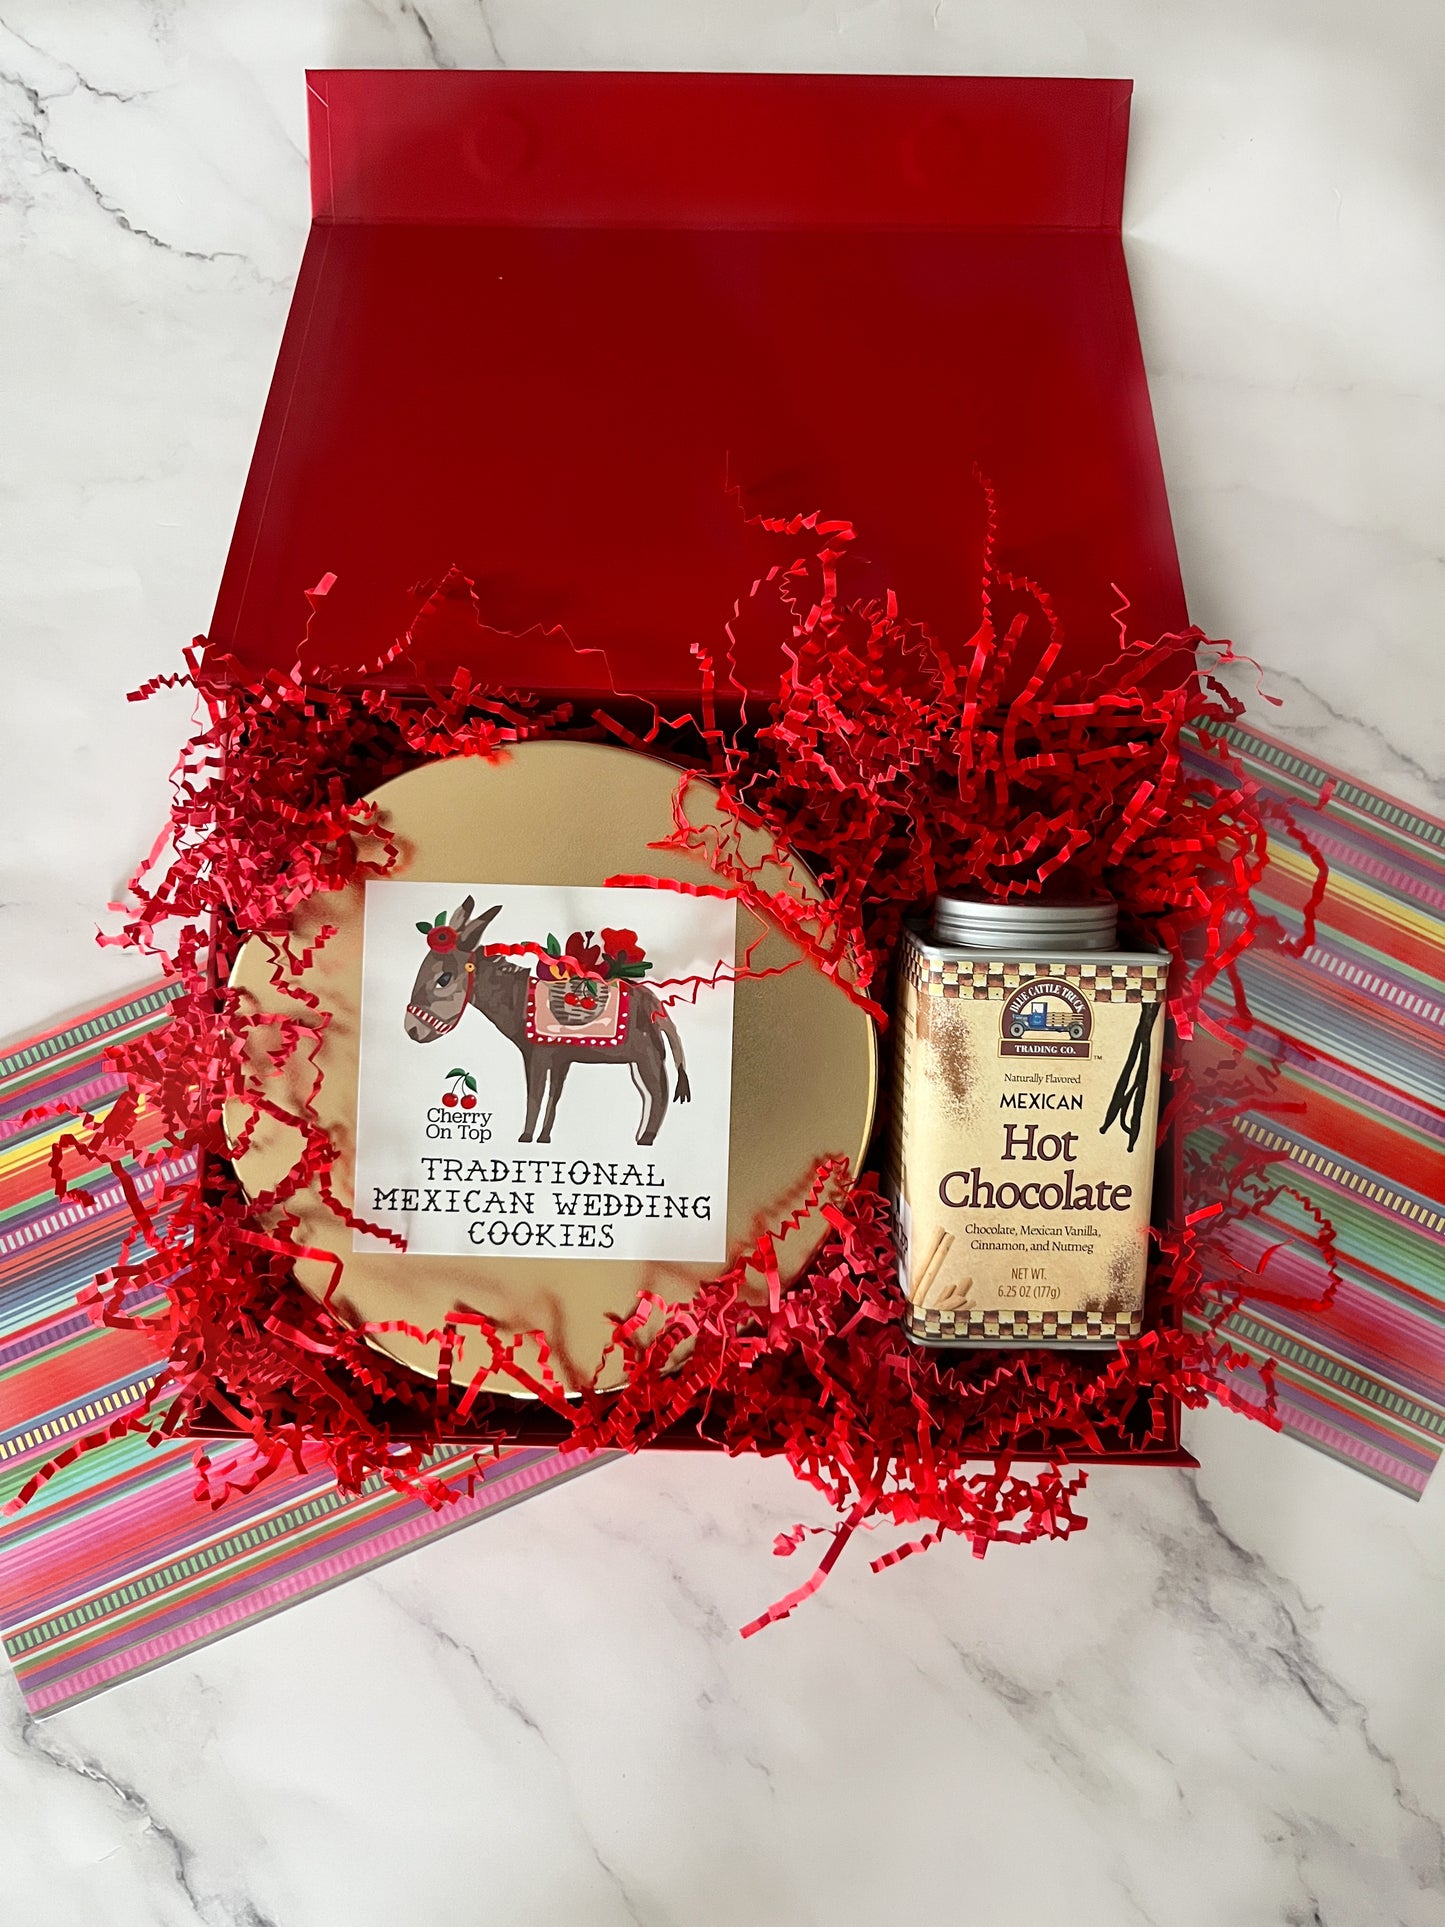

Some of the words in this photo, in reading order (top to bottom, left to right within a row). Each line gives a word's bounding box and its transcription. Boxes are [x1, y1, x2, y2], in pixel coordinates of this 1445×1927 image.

[1009, 991, 1030, 1013] BLUE
[1028, 983, 1061, 995] CATTLE
[1060, 987, 1086, 1013] TRUCK
[1014, 1045, 1058, 1054] TRADING
[1060, 1046, 1077, 1054] CO.
[1004, 1073, 1043, 1085] Naturally
[1045, 1074, 1081, 1084] Flavored
[1000, 1093, 1083, 1110] MEXICAN
[427, 1107, 493, 1127] Cherry
[426, 1124, 452, 1139] On
[458, 1125, 492, 1143] Top
[1001, 1124, 1078, 1162] Hot
[421, 1157, 666, 1187] TRADITIONAL
[938, 1168, 1133, 1211] Chocolate
[371, 1187, 536, 1215] MEXICAN
[554, 1192, 712, 1221] WEDDING
[467, 1221, 615, 1249] COOKIES
[965, 1223, 1018, 1237] Chocolate,
[1020, 1225, 1062, 1236] Mexican
[1064, 1225, 1101, 1237] Vanilla,
[970, 1240, 1028, 1252] Cinnamon,
[1030, 1241, 1050, 1251] and
[1052, 1242, 1094, 1254] Nutmeg
[1011, 1268, 1029, 1280] NET
[1031, 1268, 1047, 1280] WT.
[998, 1285, 1017, 1298] 6.25
[1019, 1286, 1031, 1298] OZ
[1033, 1286, 1061, 1299] (177g)
